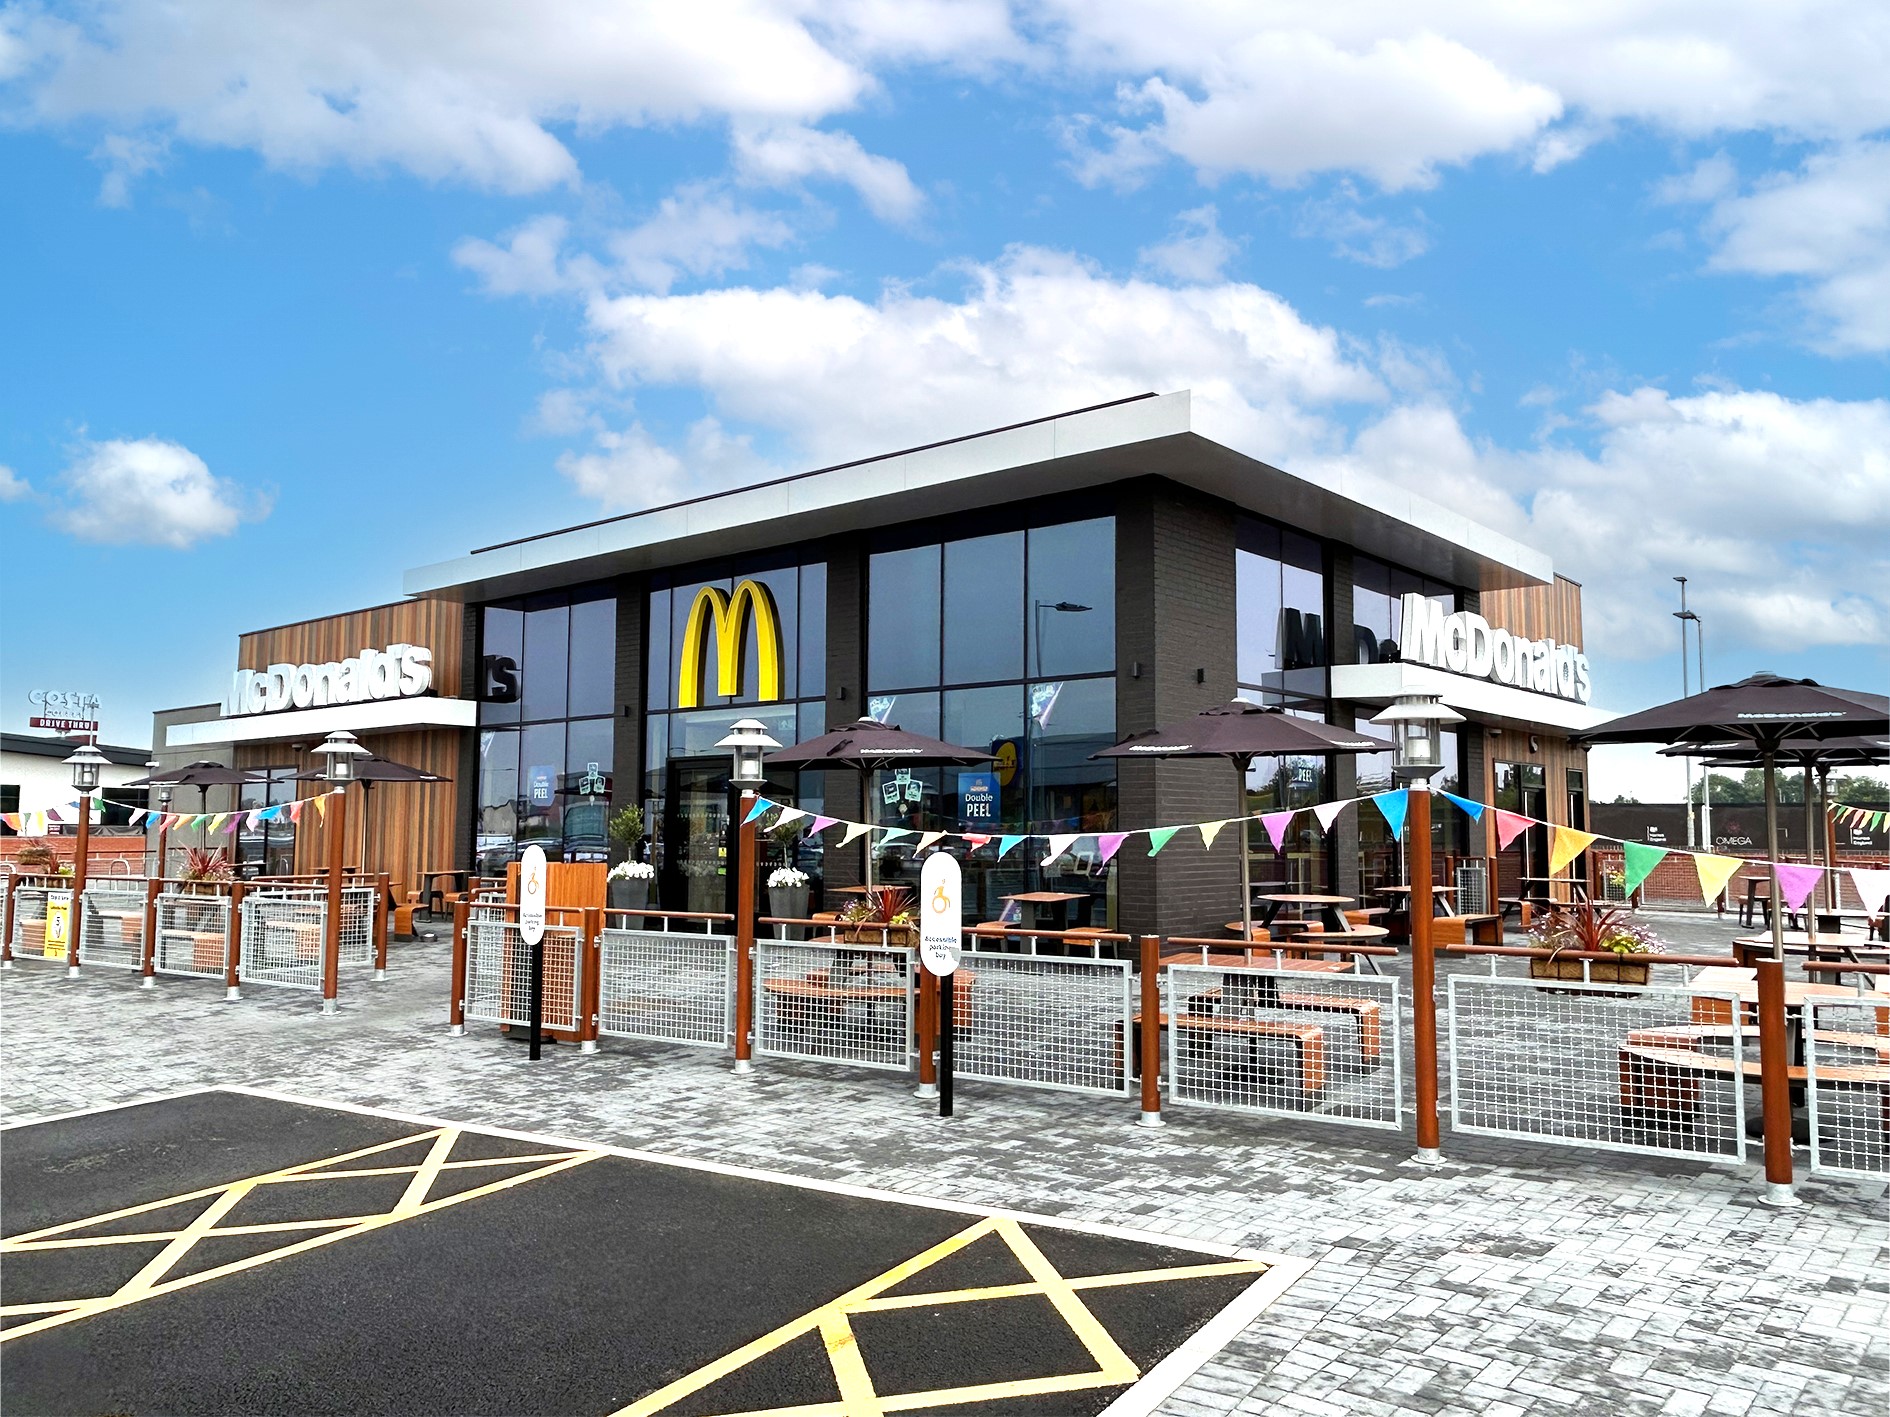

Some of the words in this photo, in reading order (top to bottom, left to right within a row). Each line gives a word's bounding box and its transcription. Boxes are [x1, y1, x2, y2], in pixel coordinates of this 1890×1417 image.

[1400, 592, 1592, 702] McDonald's
[219, 643, 433, 717] McDonald's
[28, 688, 102, 709] COSTA
[40, 719, 66, 728] DRIVE
[68, 720, 91, 730] THRU
[533, 788, 548, 799] PEEL
[965, 793, 994, 802] Double
[966, 803, 992, 817] PEEL
[1715, 836, 1753, 845] OMEGA
[936, 952, 946, 960] bay
